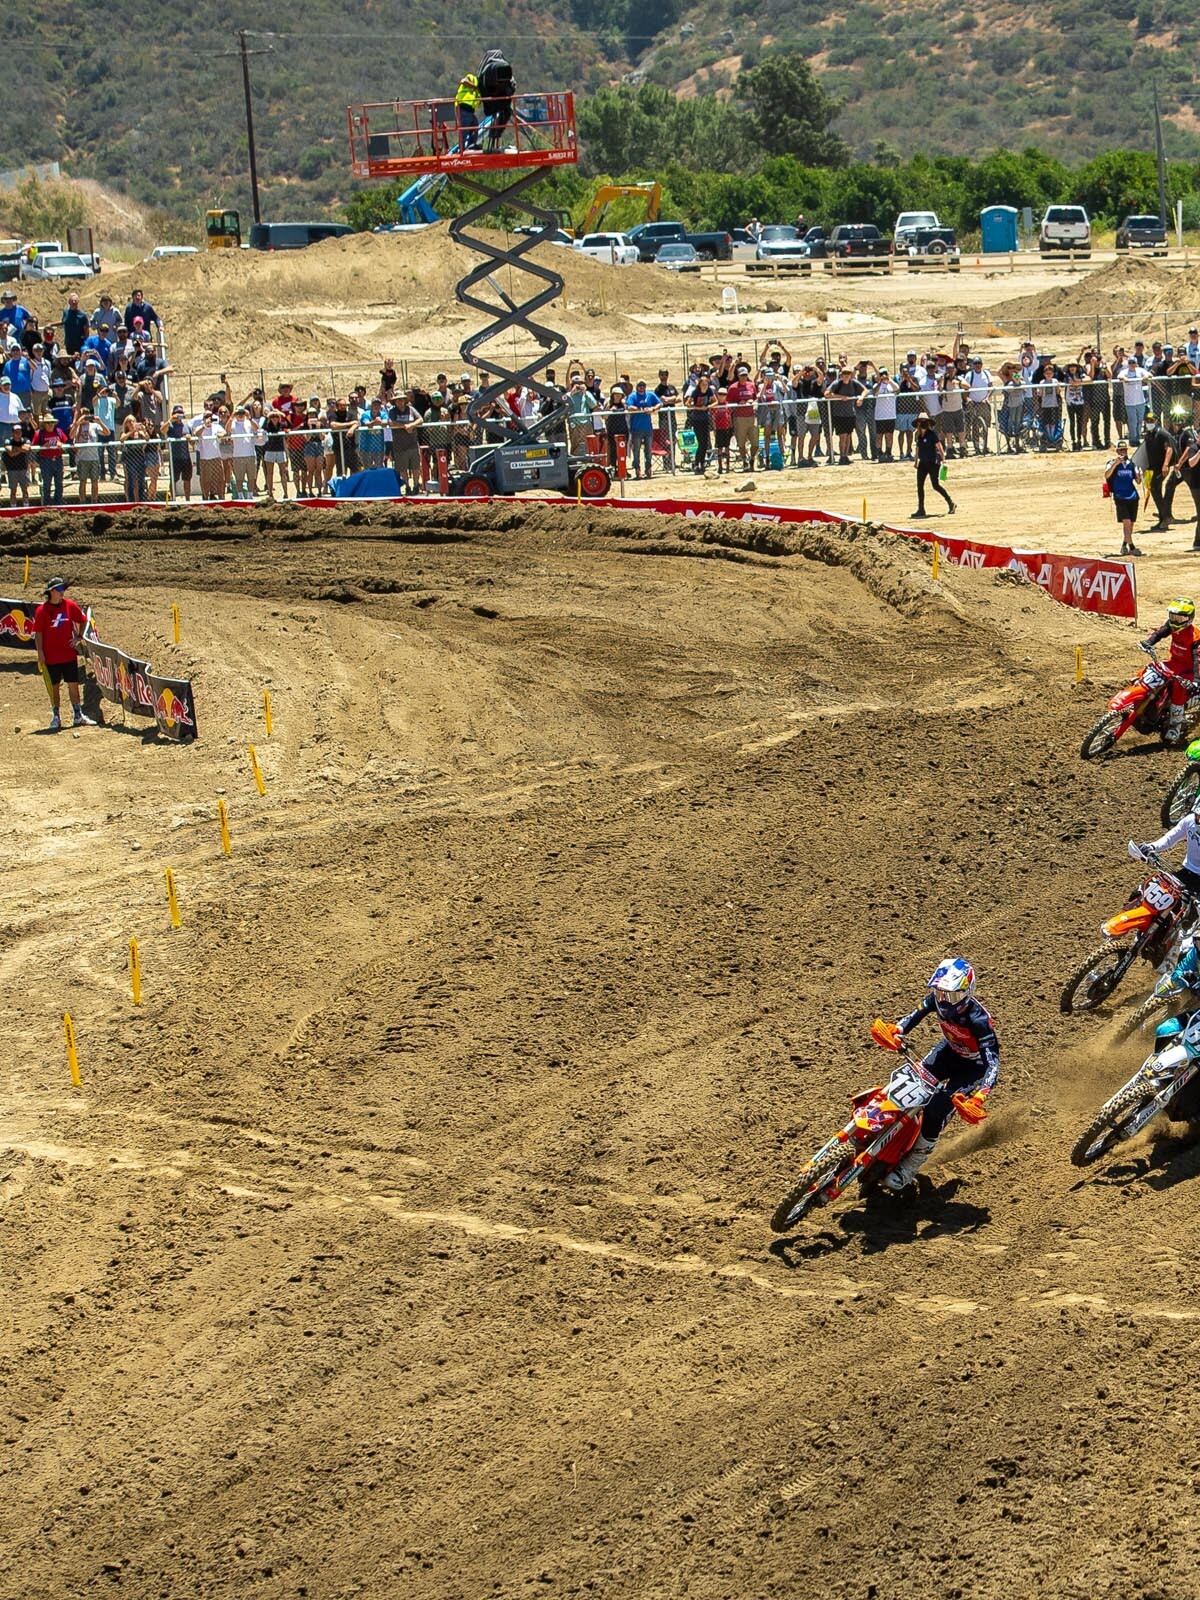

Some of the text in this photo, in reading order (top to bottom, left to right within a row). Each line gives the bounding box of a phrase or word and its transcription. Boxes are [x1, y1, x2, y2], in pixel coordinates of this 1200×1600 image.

[1062, 566, 1086, 597] MX
[1087, 571, 1126, 600] ATV
[1142, 667, 1165, 690] 162
[1143, 881, 1175, 911] 159
[886, 1070, 929, 1107] 115
[1134, 1105, 1158, 1129] DUNLOP
